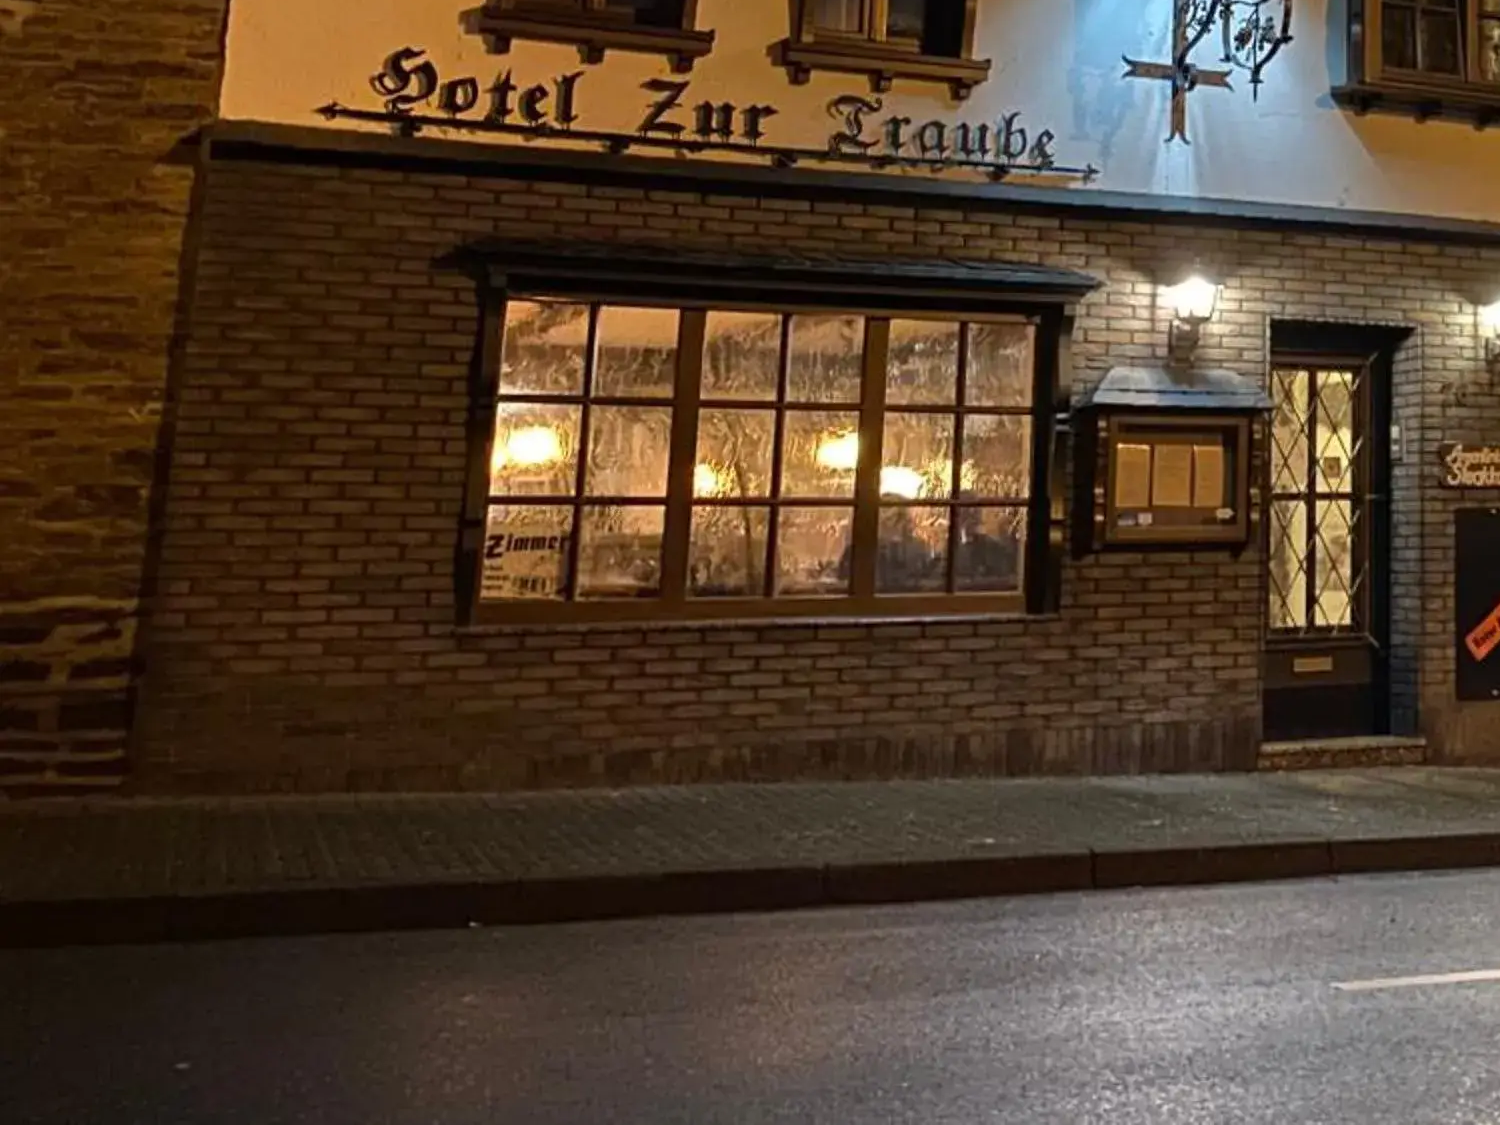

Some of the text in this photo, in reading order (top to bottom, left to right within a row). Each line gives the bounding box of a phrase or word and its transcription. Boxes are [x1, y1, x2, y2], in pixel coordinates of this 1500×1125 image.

[369, 46, 1056, 166] Hotel Zur Traube
[485, 533, 568, 560] Zimmer
